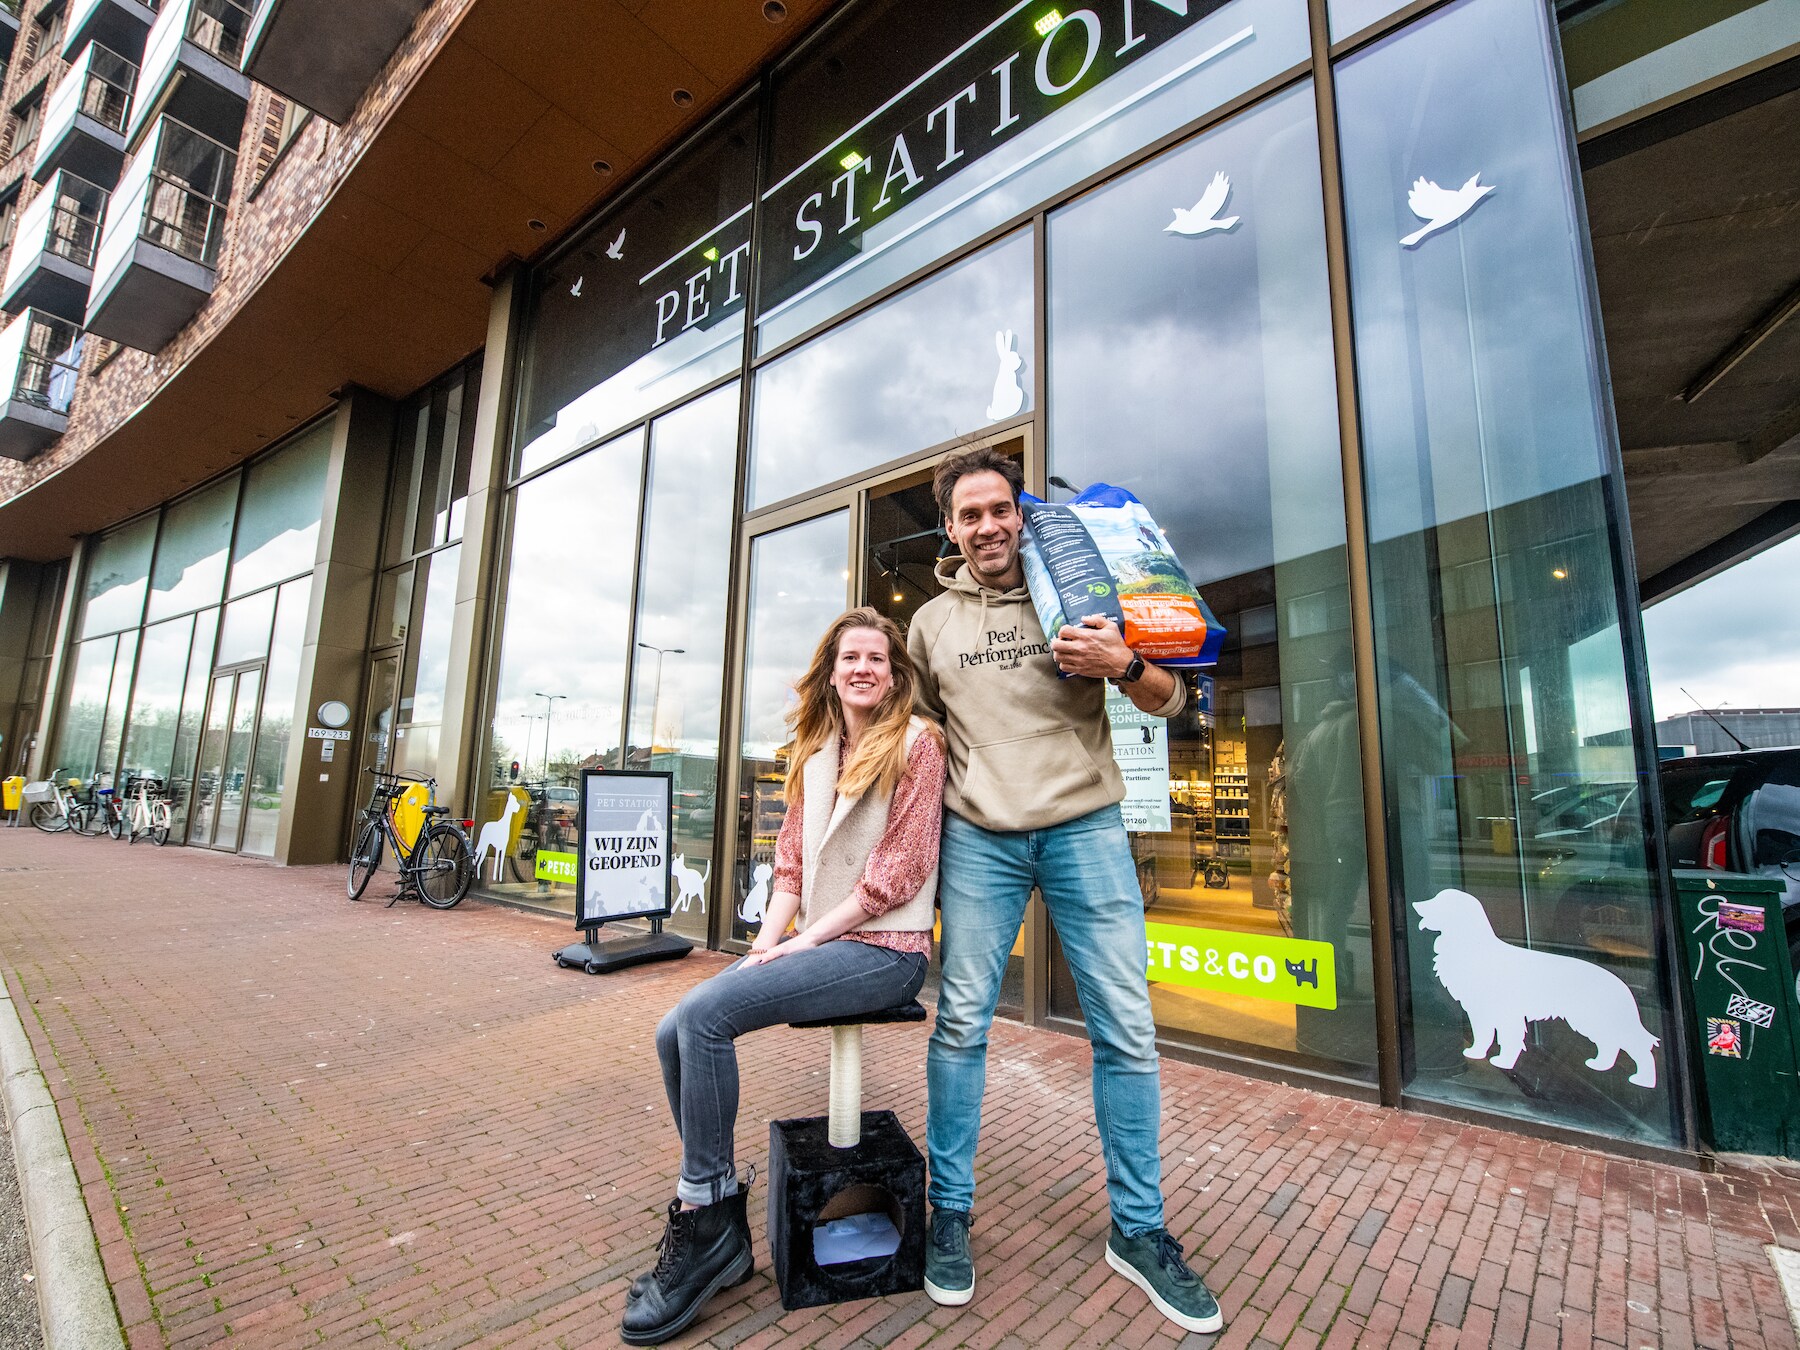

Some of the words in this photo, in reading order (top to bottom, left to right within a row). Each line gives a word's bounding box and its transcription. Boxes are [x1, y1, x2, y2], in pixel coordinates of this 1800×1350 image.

[651, 240, 750, 348] PET
[958, 642, 1051, 669] Performanc
[310, 729, 326, 737] 169
[333, 731, 348, 739] 233
[597, 798, 617, 808] PET
[619, 798, 659, 809] STATION
[594, 837, 623, 854] WIJ
[626, 836, 659, 852] ZIJN
[547, 860, 576, 876] PETS&
[589, 854, 661, 871] GEOPEND
[1147, 940, 1276, 983] ETS&CO
